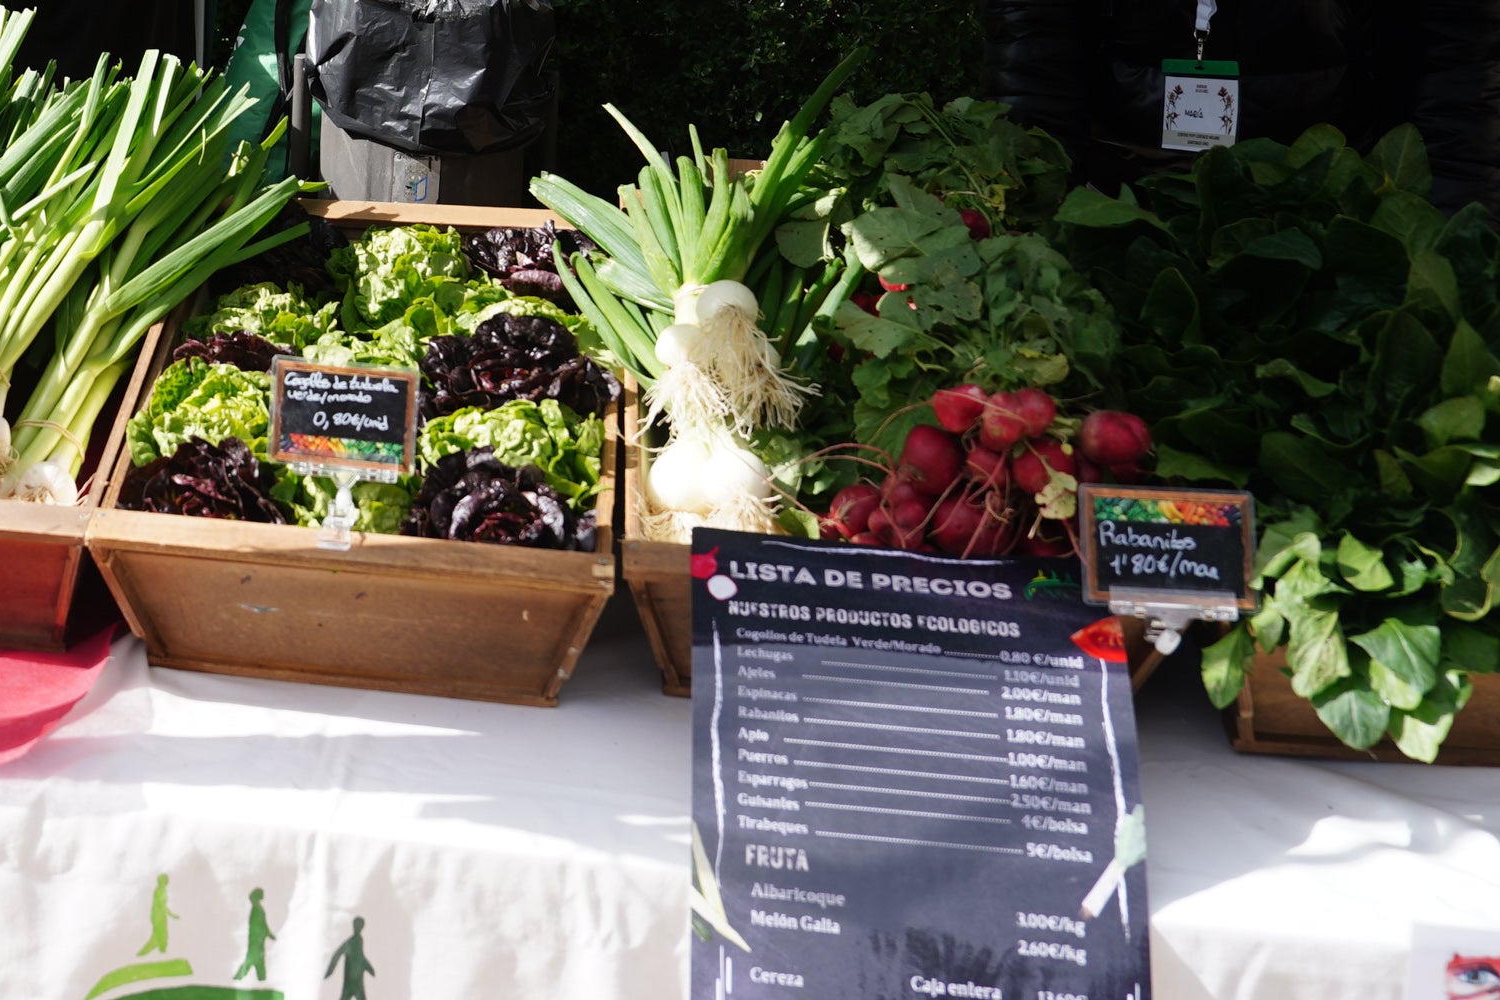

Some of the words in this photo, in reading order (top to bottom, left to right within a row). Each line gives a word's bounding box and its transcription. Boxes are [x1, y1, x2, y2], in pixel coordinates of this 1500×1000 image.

[332, 374, 348, 390] de
[729, 560, 817, 586] LISTA
[823, 568, 864, 590] DE
[871, 572, 1013, 600] PRECIOS
[728, 600, 811, 622] NUESTROS
[815, 606, 912, 630] PRODUCTOS
[916, 614, 1021, 639] ECOLOGICOS
[735, 626, 787, 642] Cogollos
[788, 631, 805, 644] de
[805, 632, 848, 647] Tudela
[851, 635, 942, 654] Verde/Morado
[736, 646, 795, 663] Lechugas
[737, 664, 776, 680] Ajetes
[1001, 686, 1082, 706] 2.00€/man
[737, 685, 798, 702] Espinacas
[1004, 706, 1084, 726] 1.80€/man
[738, 706, 800, 724] Rabanitos
[1006, 728, 1086, 750] 1.80€/man
[738, 726, 770, 743] Apio
[738, 748, 789, 766] Puerros
[1010, 774, 1090, 796] 1.60€/man
[737, 792, 800, 812] Guisantes
[1010, 793, 1093, 816] 2.50€/man
[737, 814, 810, 837] Tirabeques
[1026, 842, 1094, 864] 5€/bolsa
[744, 844, 810, 872] FRUTA
[750, 882, 847, 909] Albaricoque
[1014, 911, 1086, 939] 3.00€/kg
[750, 909, 799, 930] Melón
[800, 914, 842, 935] Galia
[1017, 939, 1088, 967] 2.60€/kg
[750, 966, 805, 988] Cereza
[910, 974, 946, 999] Caja
[947, 980, 1003, 1000] entera
